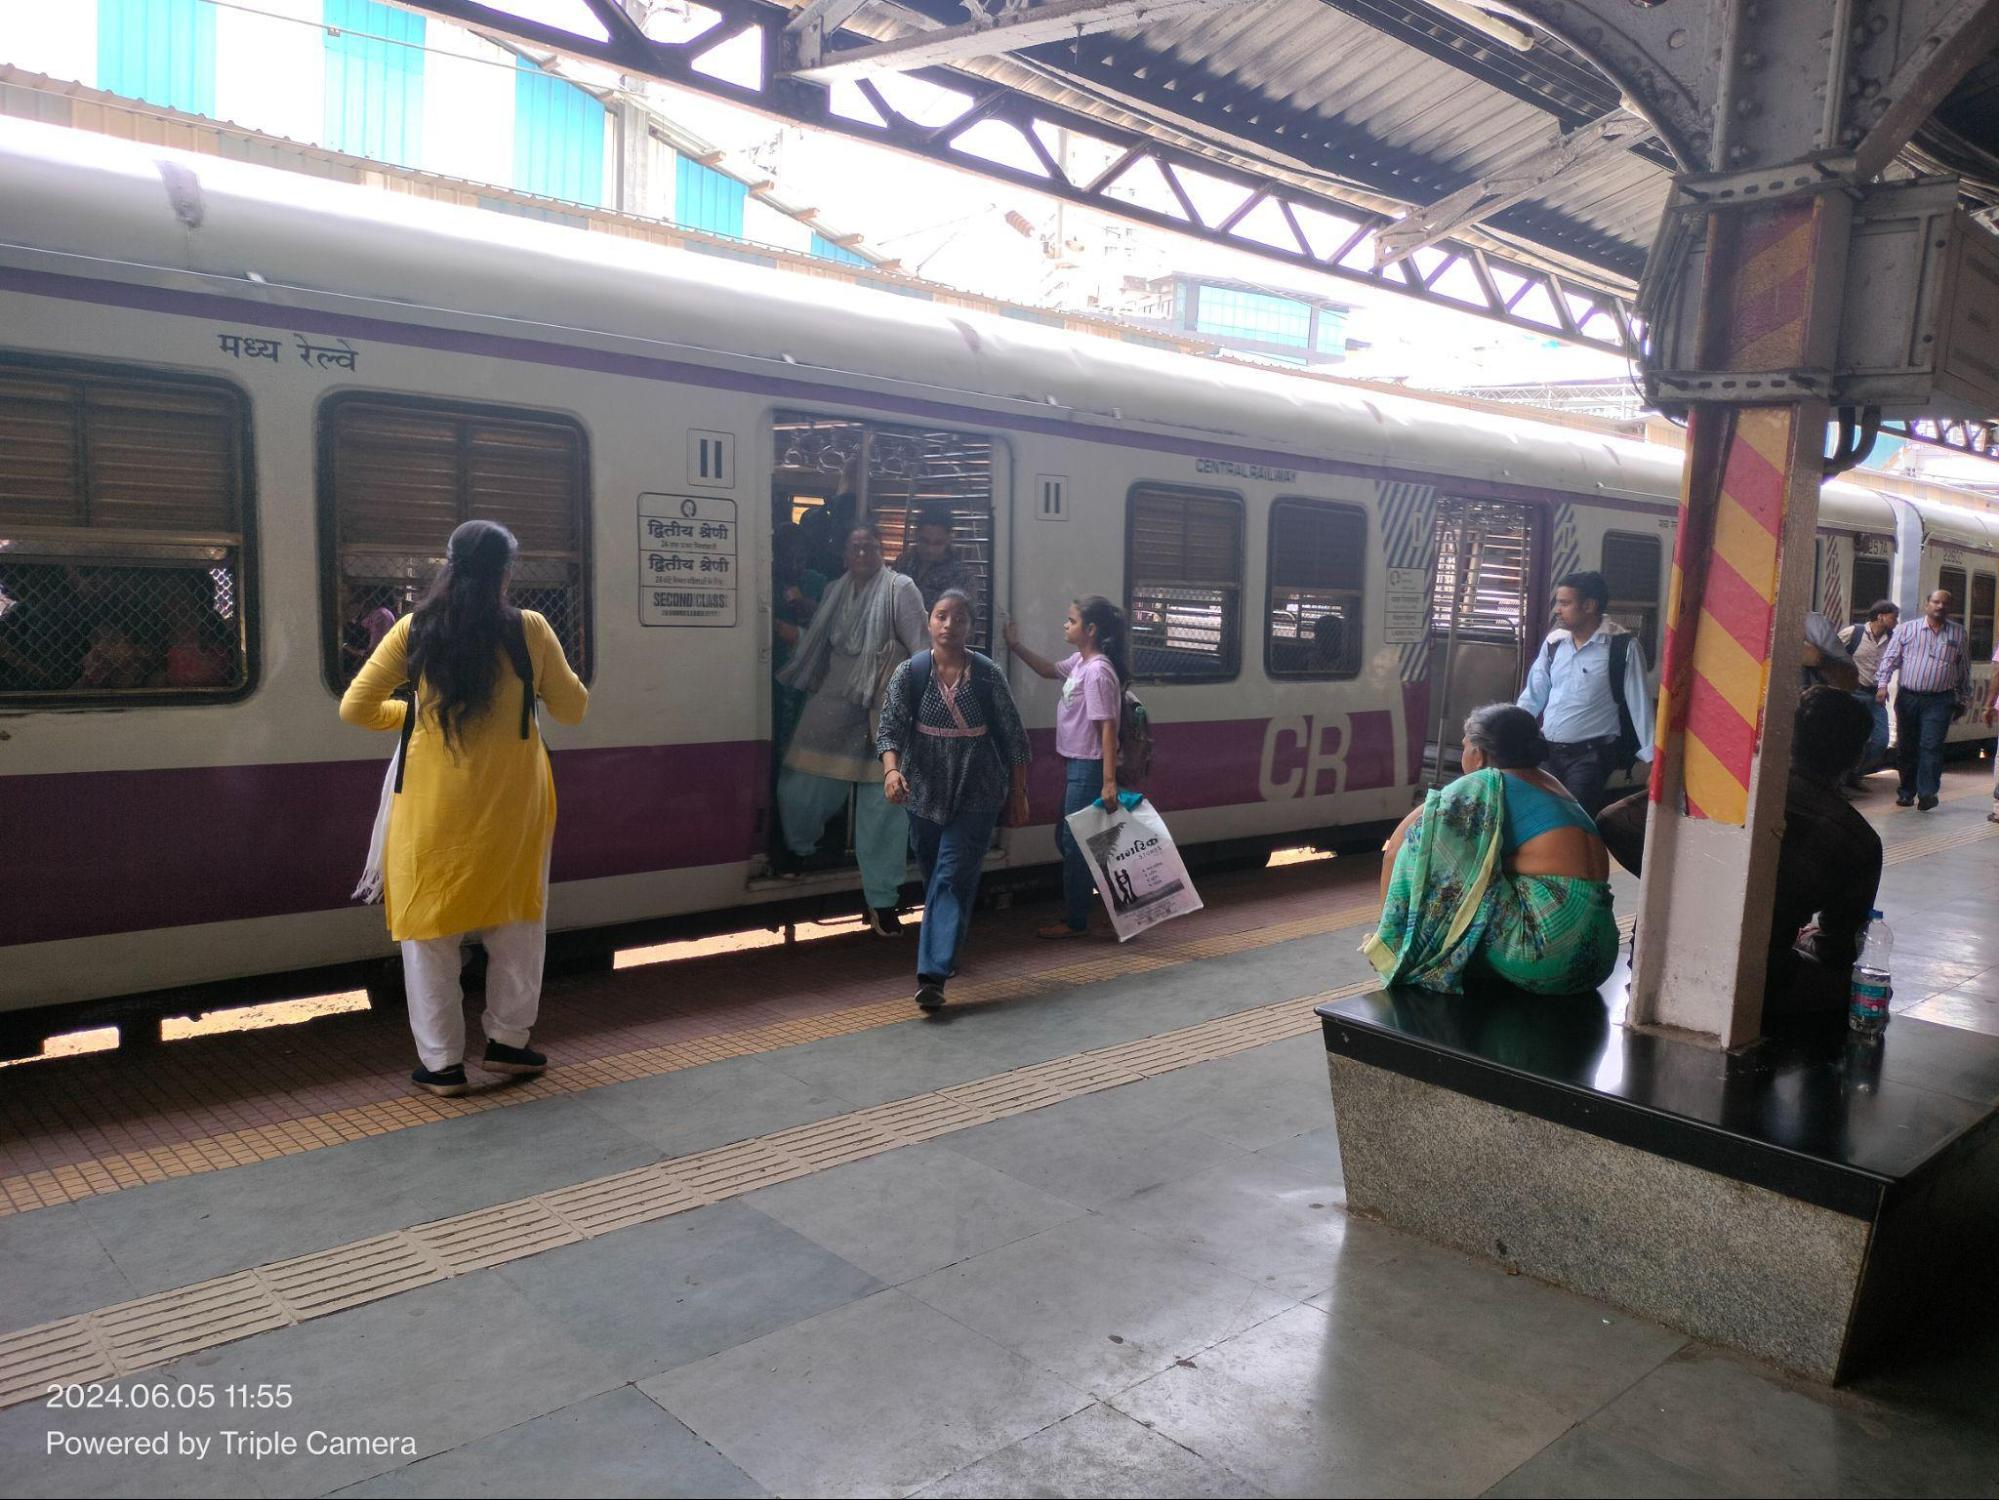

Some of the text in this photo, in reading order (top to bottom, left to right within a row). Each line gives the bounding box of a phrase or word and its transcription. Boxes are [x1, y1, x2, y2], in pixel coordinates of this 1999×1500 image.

[217, 333, 359, 372] मध्य रेल्वे
[647, 520, 728, 540] द्वितीय श्रेणी
[648, 553, 729, 572] द्वितीय श्रेणी
[653, 591, 727, 609] SECOND CLASS
[1259, 714, 1352, 801] CR
